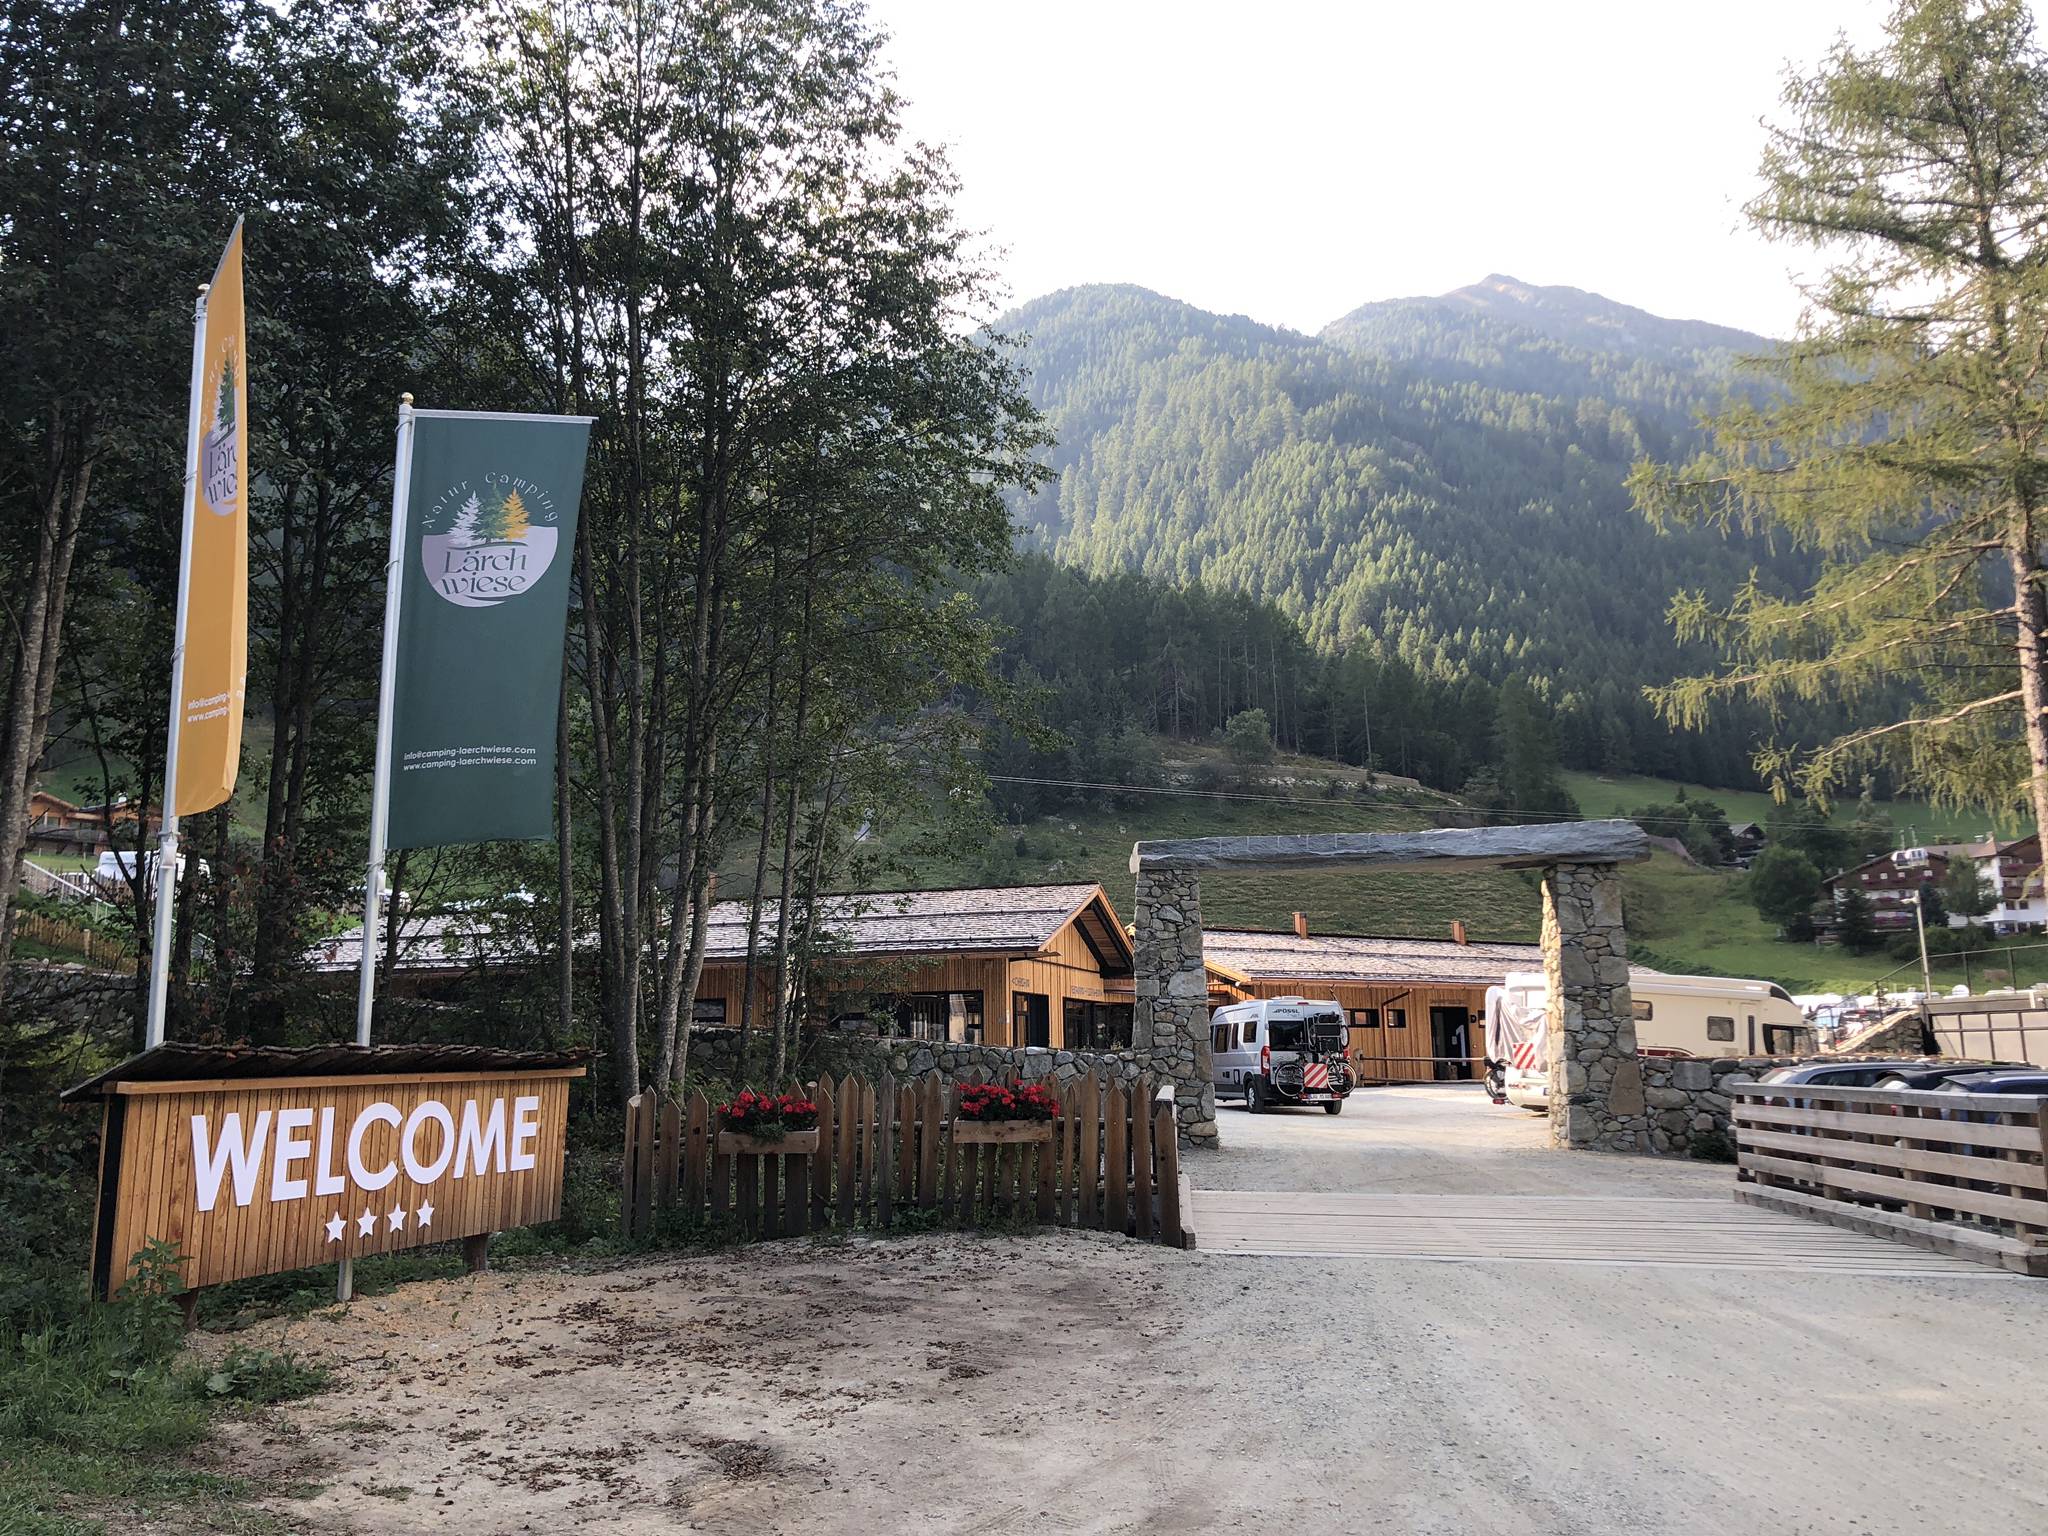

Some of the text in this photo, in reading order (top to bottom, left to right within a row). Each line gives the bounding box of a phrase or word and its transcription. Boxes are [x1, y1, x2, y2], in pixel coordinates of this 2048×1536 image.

[485, 472, 559, 522] Camping
[443, 547, 527, 574] Lärch
[441, 572, 526, 595] wiese
[403, 744, 536, 760] info@camping-laerchwiese.com
[403, 755, 537, 771] www.camping-laerchwiese.com
[191, 1095, 540, 1212] WELCOME
